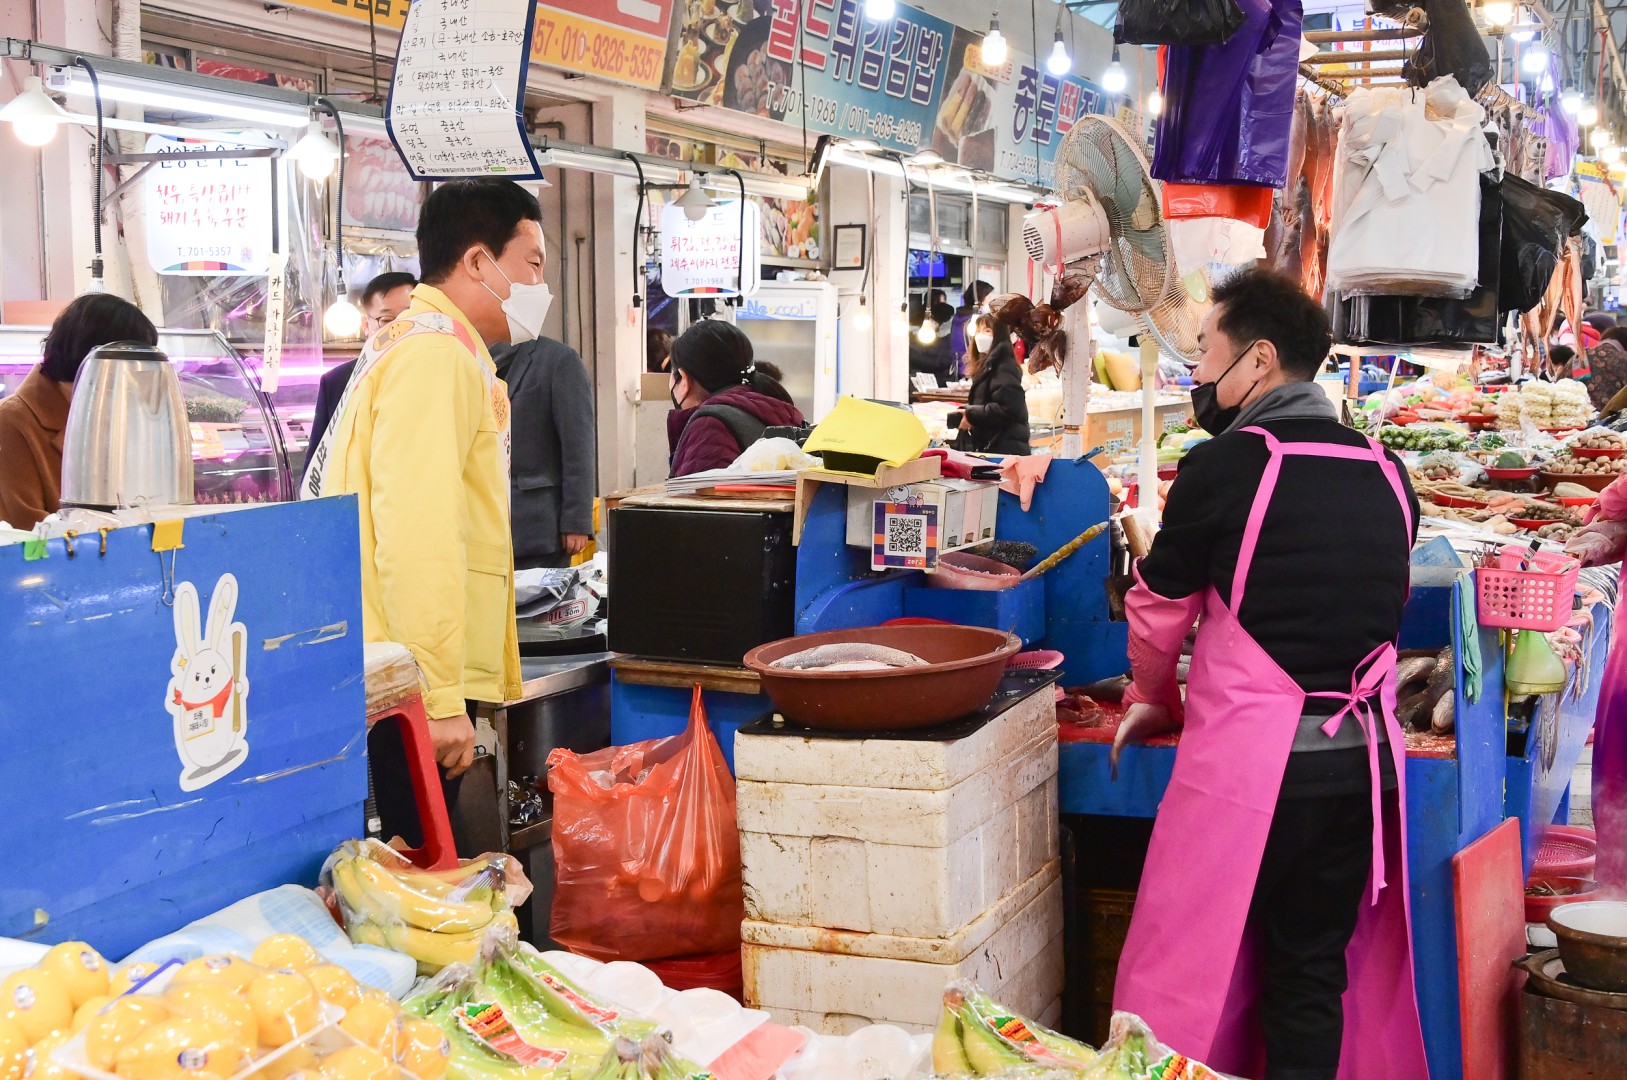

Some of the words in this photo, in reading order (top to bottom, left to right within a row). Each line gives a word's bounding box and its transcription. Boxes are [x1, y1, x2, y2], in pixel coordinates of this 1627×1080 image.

[439, 16, 468, 30] 국내산
[403, 37, 427, 51] 단무지
[438, 50, 468, 62] 국내산
[440, 117, 466, 133] 중국산
[848, 106, 922, 147] 011-865-2623
[406, 137, 427, 149] 당근
[445, 135, 473, 147] 중국산
[685, 277, 724, 285] T.701-1968
